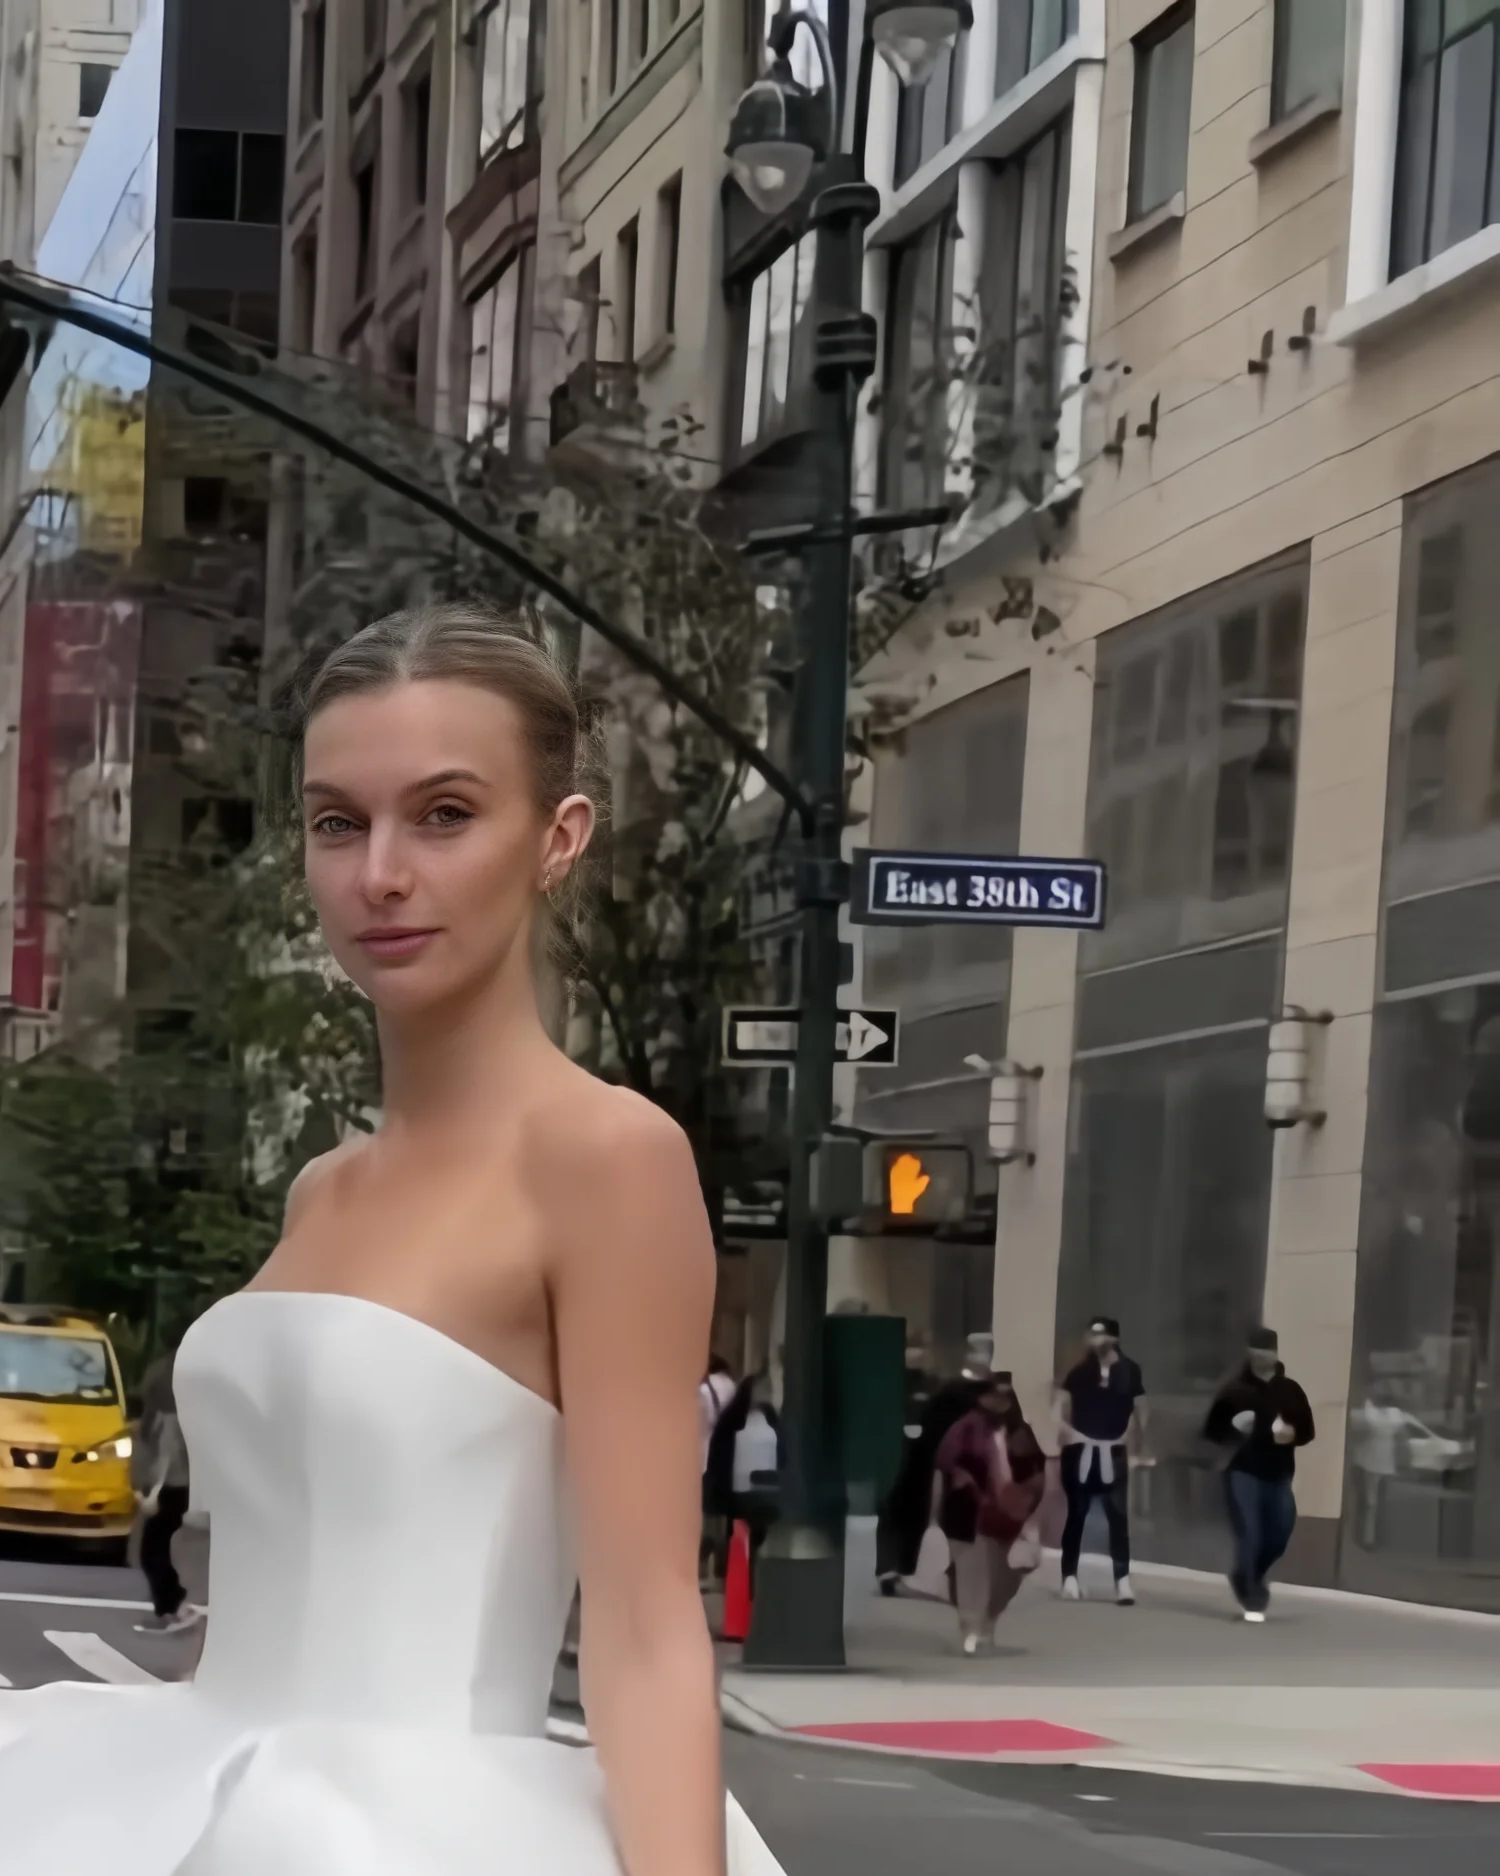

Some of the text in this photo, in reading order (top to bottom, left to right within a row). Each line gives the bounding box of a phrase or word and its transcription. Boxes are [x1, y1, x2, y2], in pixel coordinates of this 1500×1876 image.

[886, 869, 1088, 912] East 38th St
